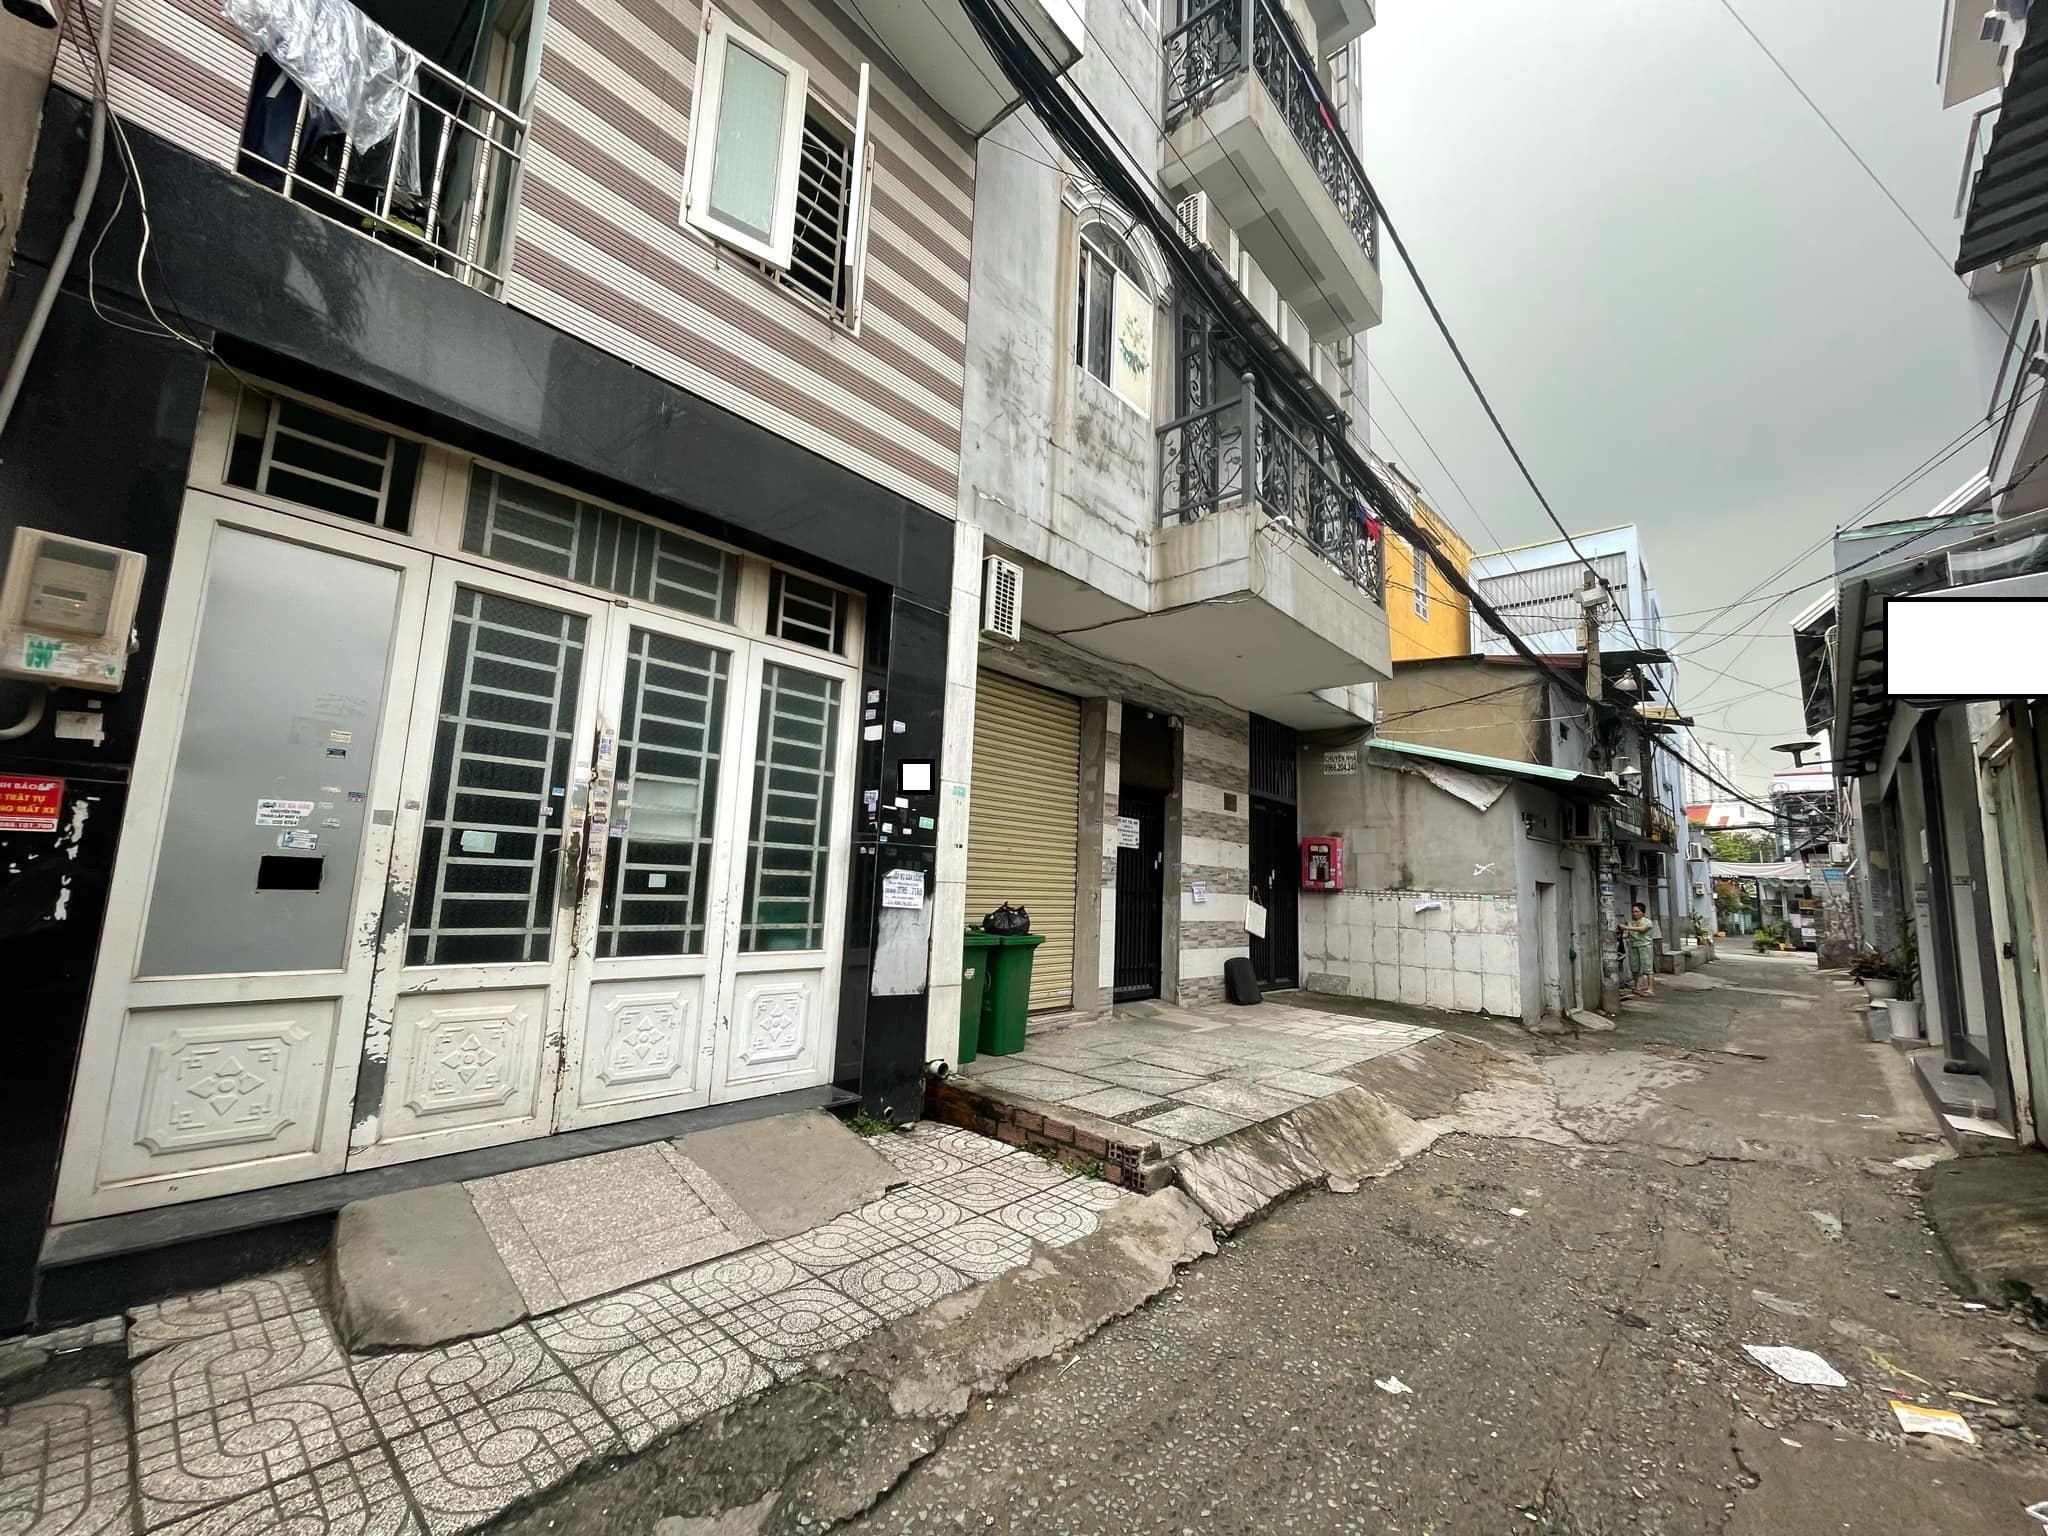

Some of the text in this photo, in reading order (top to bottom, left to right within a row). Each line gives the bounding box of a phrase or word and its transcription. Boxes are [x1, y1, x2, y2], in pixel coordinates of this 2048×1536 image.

[14, 781, 37, 790] BÁO
[4, 792, 46, 804] TRẬT TỰ
[16, 804, 40, 813] MẤT
[42, 806, 56, 814] XE
